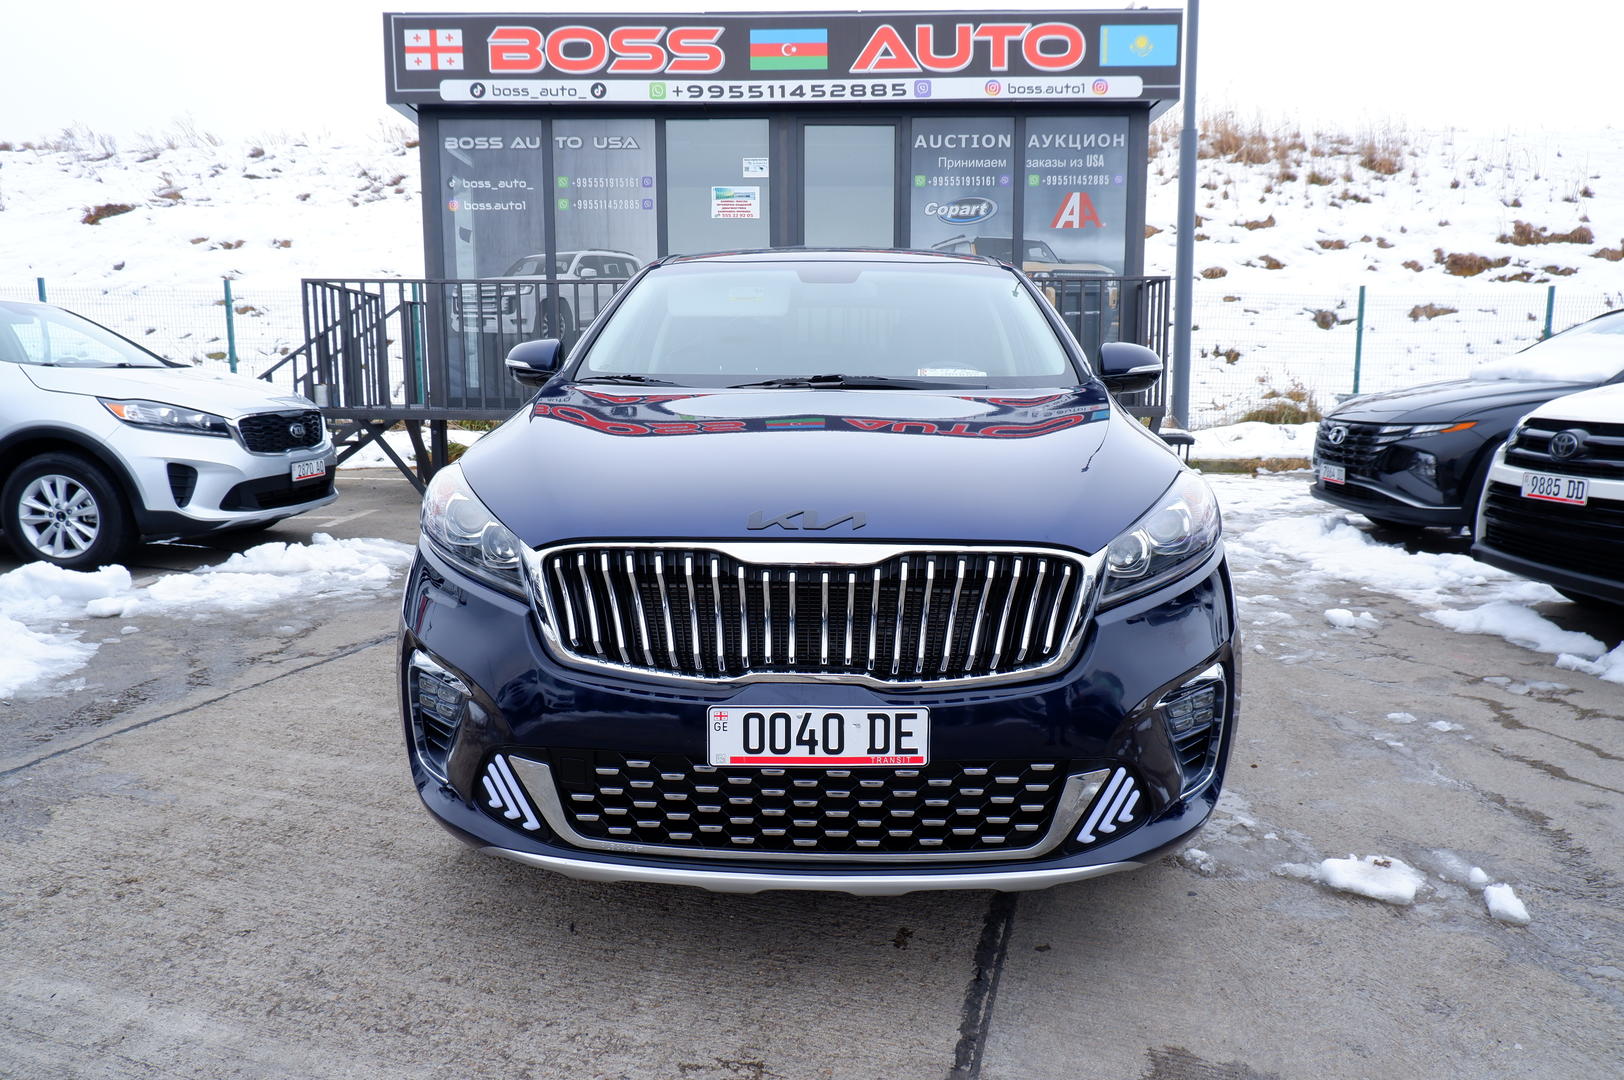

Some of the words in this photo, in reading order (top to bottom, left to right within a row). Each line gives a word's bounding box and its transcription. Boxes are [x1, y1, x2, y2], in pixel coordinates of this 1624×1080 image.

[486, 25, 726, 74] BOSS
[849, 22, 1086, 73] AUTO
[491, 84, 588, 99] boss_auto_
[672, 83, 908, 99] +995511452885
[1007, 82, 1086, 96] boss.auto1
[444, 136, 503, 150] BOSS
[593, 136, 640, 150] USA
[914, 134, 1011, 149] AUCTION
[1028, 133, 1125, 150] АУКЦИОН
[938, 157, 1007, 170] Принимаем
[1026, 159, 1067, 168] заказы
[1070, 159, 1083, 168] из
[1086, 154, 1105, 168] USA
[463, 177, 534, 190] boss_auto_
[464, 200, 527, 210] boss.auto1
[924, 200, 989, 217] Copart
[1531, 475, 1561, 497] 9885
[1567, 479, 1585, 500] DD
[713, 721, 728, 732] GE
[742, 712, 845, 755] 0040
[866, 712, 919, 755] DE
[870, 756, 912, 764] TRANSIT
